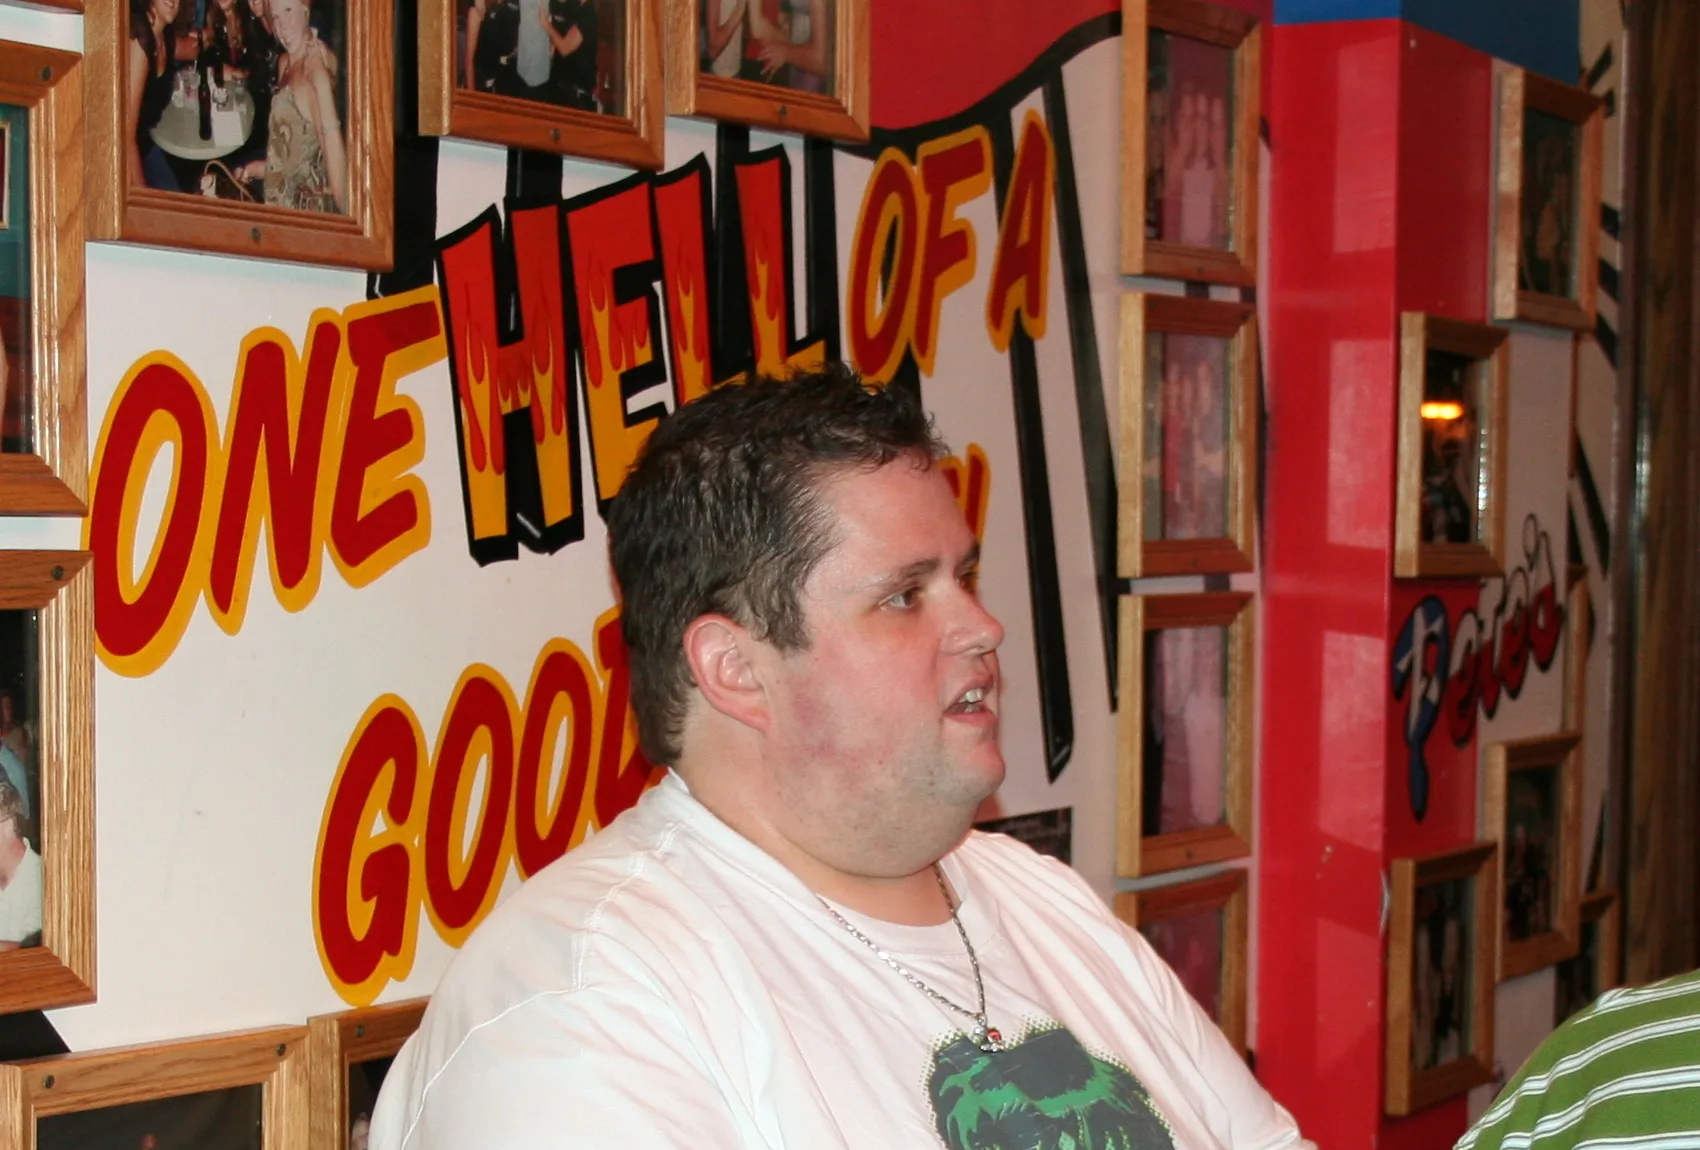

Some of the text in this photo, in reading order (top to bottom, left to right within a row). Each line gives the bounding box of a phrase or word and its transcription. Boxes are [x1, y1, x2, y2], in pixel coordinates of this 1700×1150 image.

[83, 285, 448, 678] ONE
[435, 145, 845, 566] HELL
[848, 124, 993, 386] OF
[987, 108, 1054, 353] A
